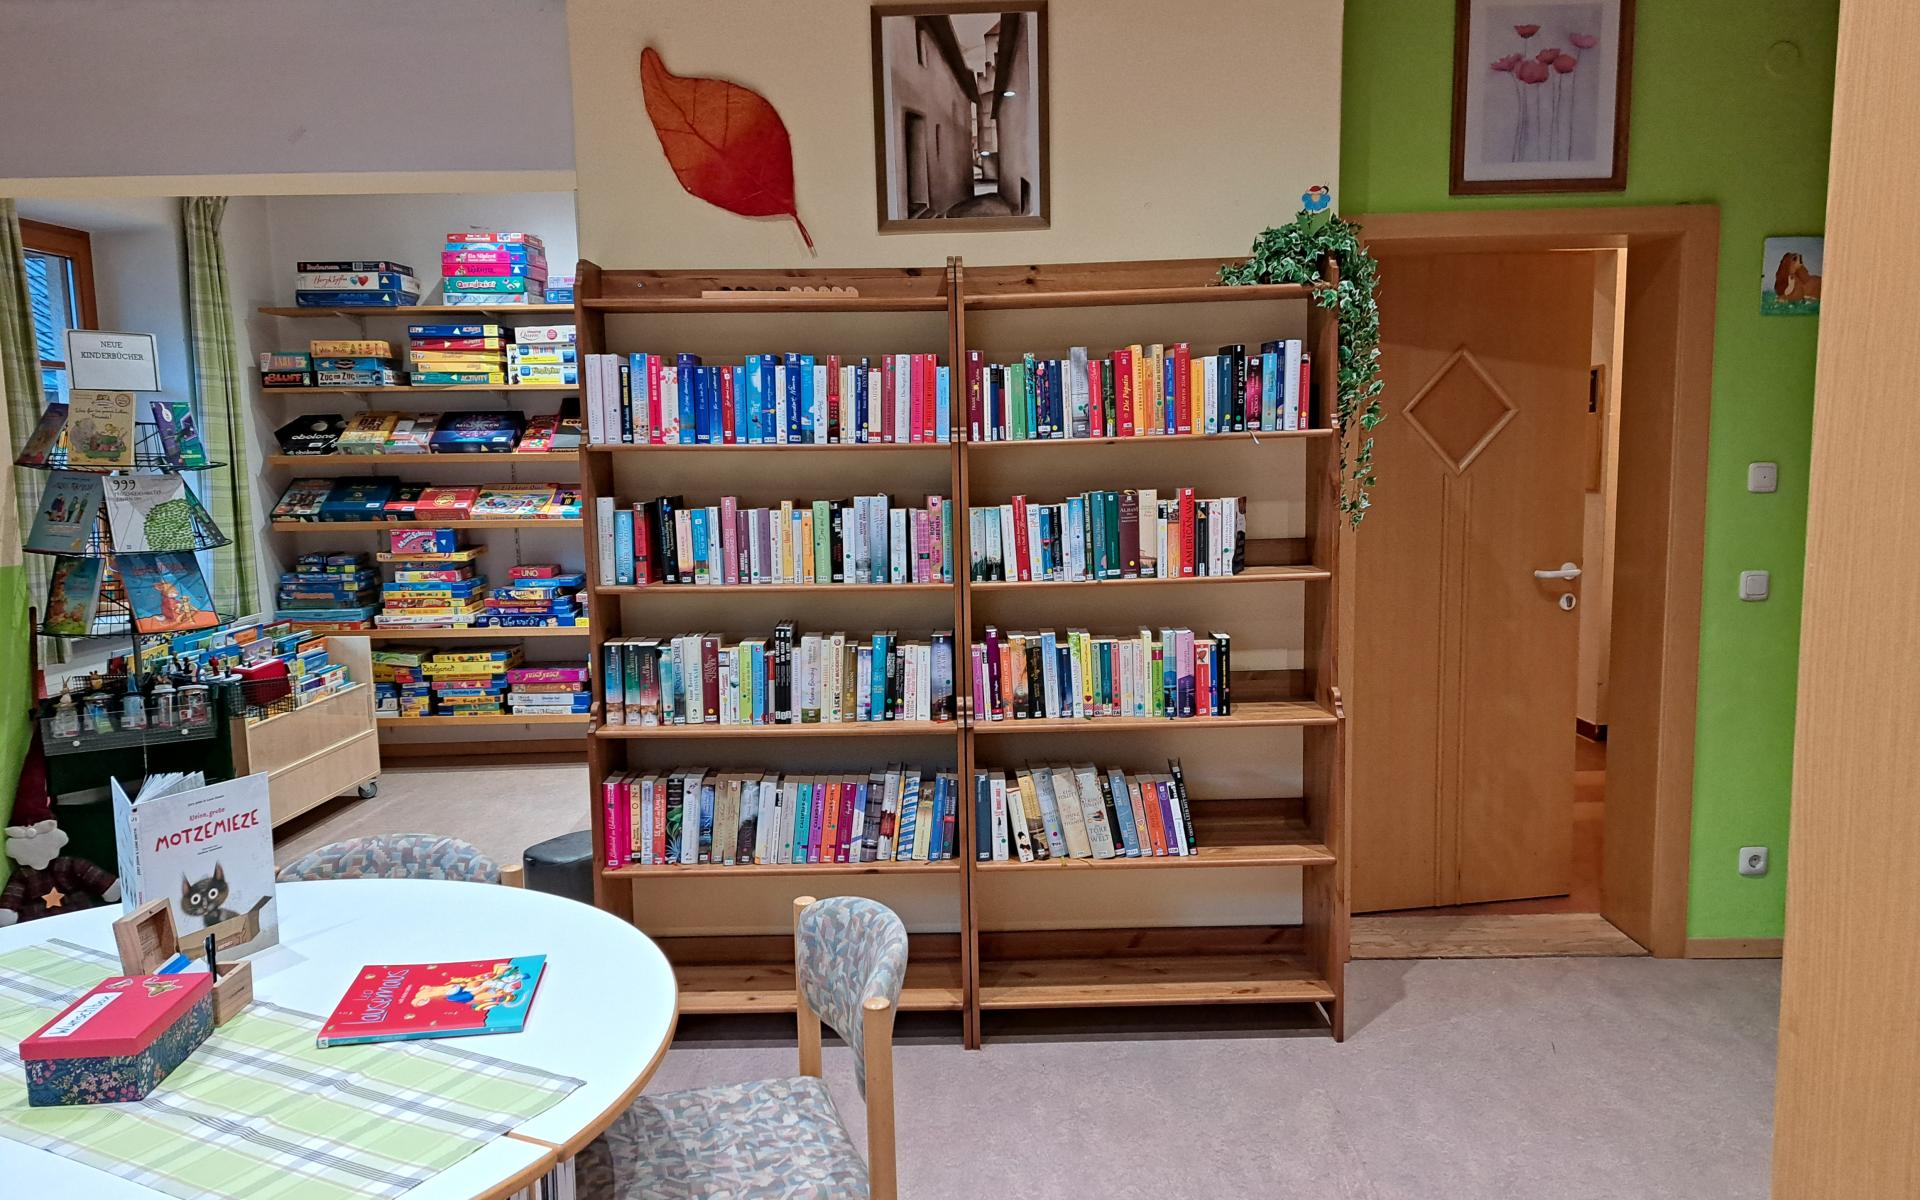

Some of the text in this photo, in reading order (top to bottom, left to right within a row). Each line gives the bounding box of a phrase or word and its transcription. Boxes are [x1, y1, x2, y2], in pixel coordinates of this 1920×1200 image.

[100, 340, 123, 349] NEUE
[80, 351, 144, 361] KINDERBÜCHER
[113, 480, 136, 491] 999
[1185, 516, 1193, 564] AMERICAN
[155, 808, 260, 852] MOTZEMIEZE
